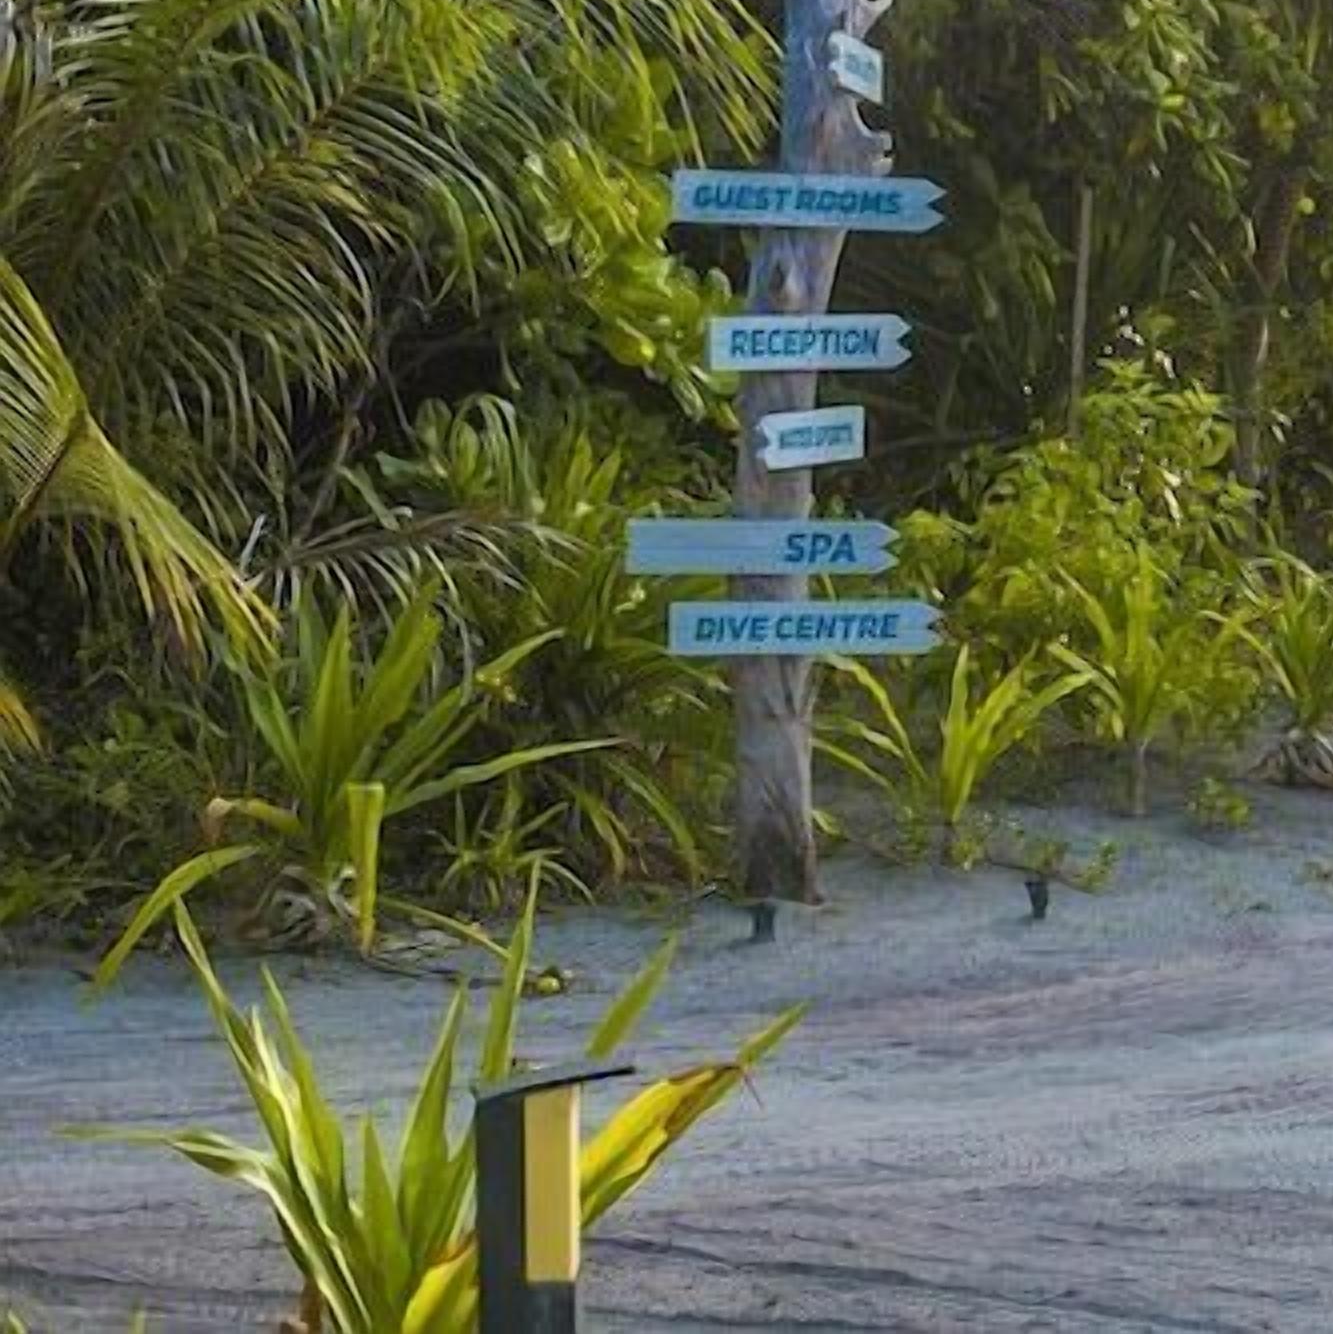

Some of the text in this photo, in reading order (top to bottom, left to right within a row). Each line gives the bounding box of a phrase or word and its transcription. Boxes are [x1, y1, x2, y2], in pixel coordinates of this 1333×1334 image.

[693, 184, 904, 214] GUEST ROOMS
[730, 329, 880, 358] RECEPTION
[785, 532, 857, 563] SPA
[695, 615, 900, 642] DIVE CENTRE
